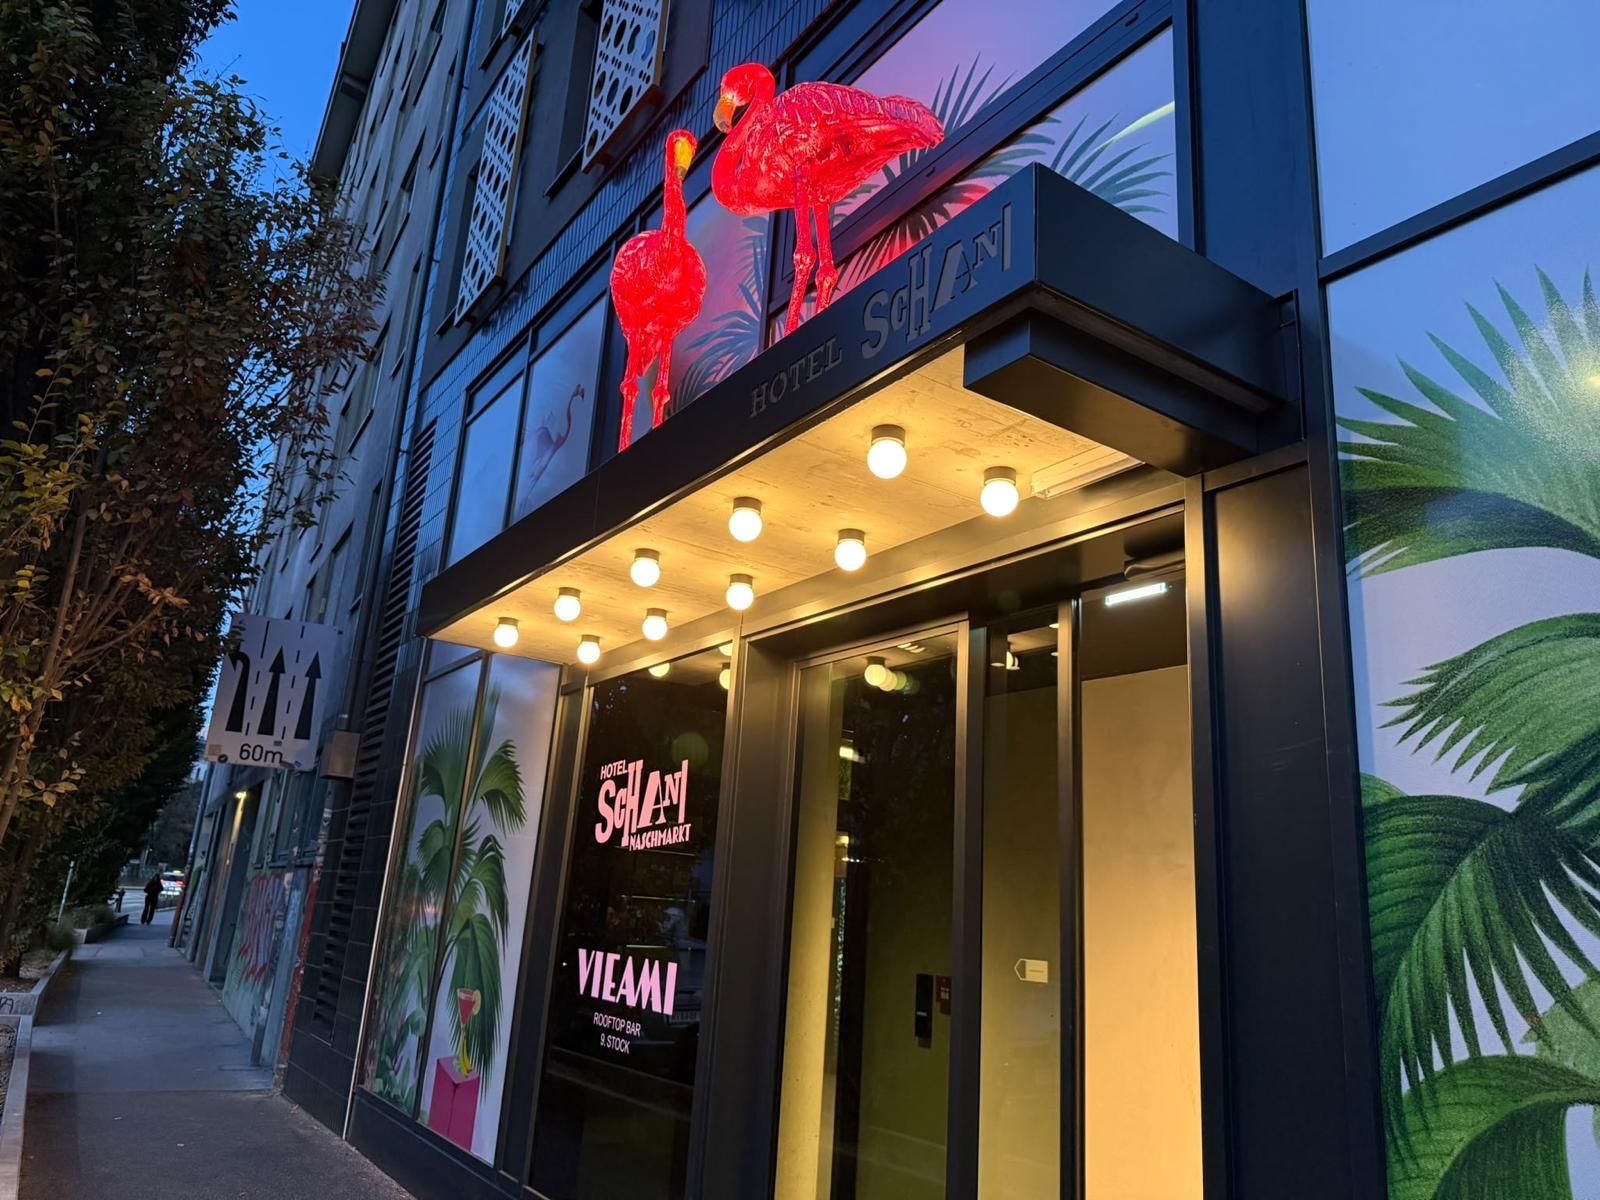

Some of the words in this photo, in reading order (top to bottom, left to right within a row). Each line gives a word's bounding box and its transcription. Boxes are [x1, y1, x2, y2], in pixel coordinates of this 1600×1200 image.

[750, 336, 843, 418] HOTEL
[239, 743, 283, 763] 60m
[600, 760, 628, 780] HOTEL
[629, 824, 692, 852] NASCHMARKT
[578, 948, 678, 1016] VIEAMI
[593, 1012, 626, 1031] ROOFTOP
[625, 1020, 642, 1037] BAR
